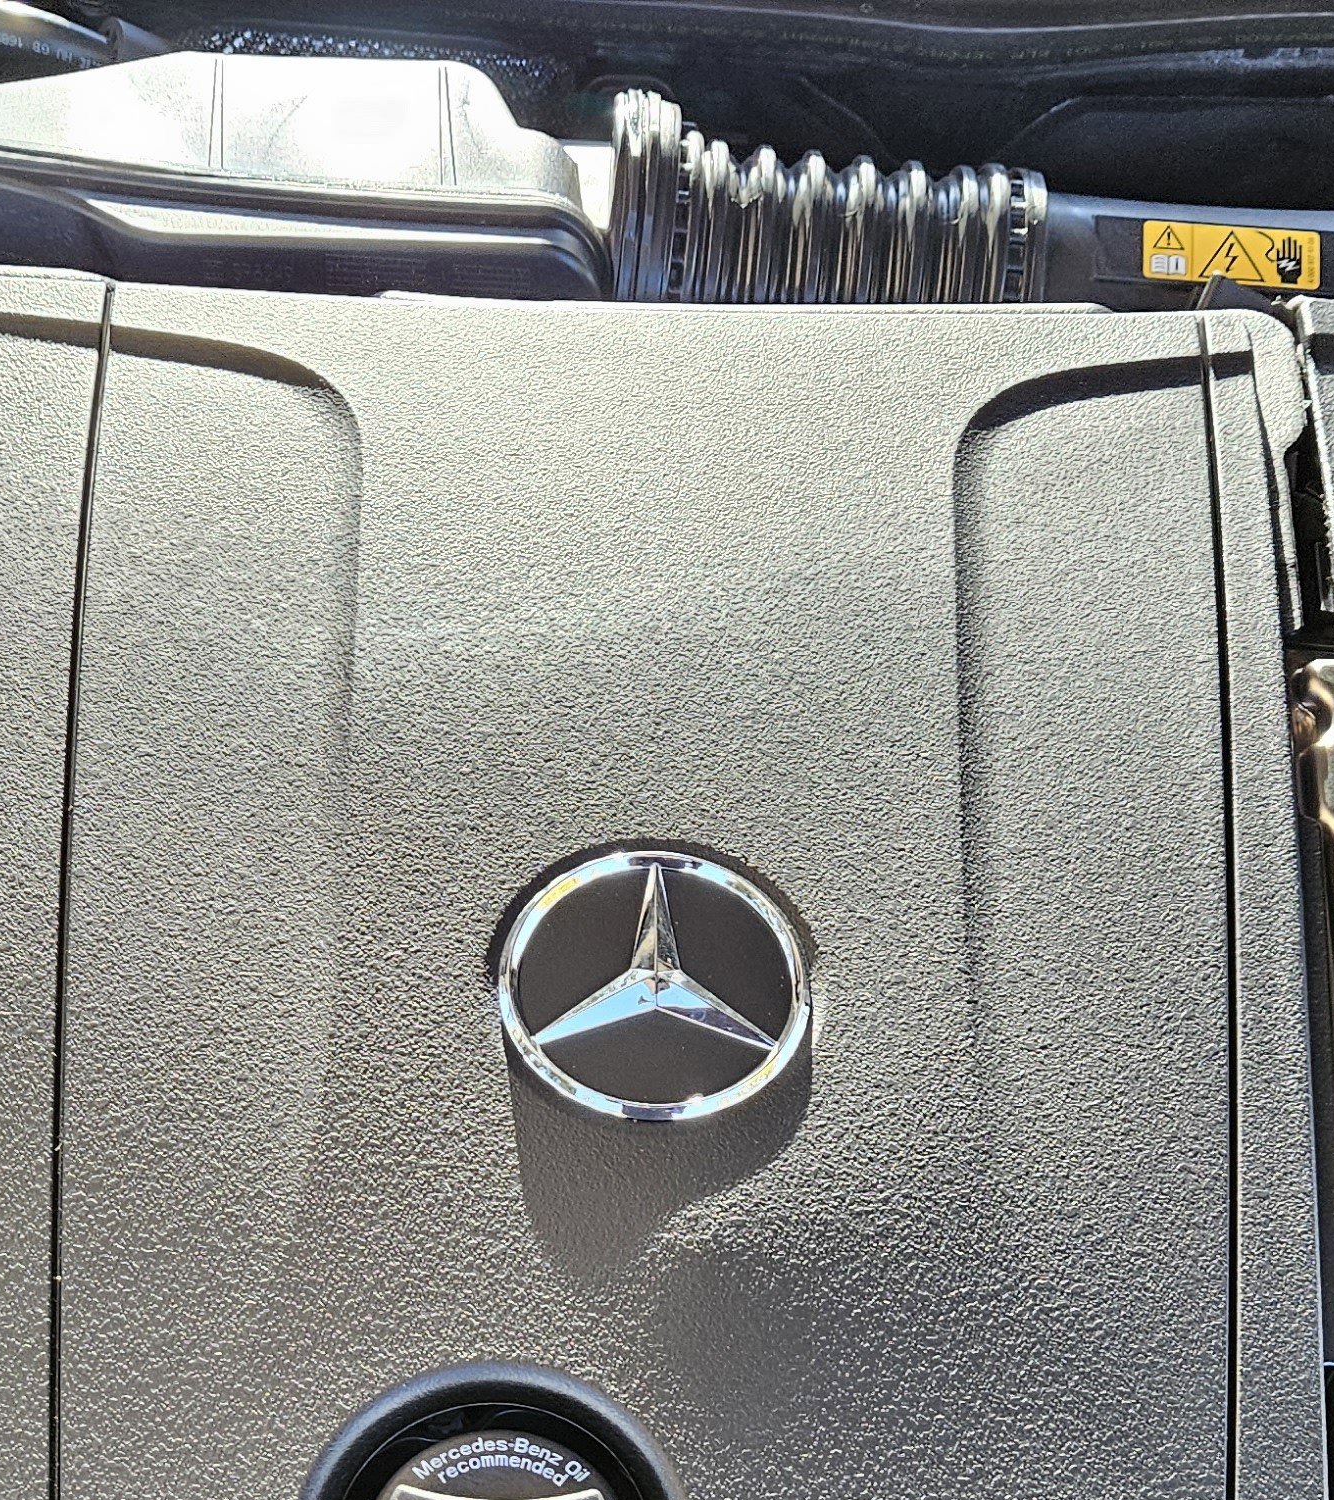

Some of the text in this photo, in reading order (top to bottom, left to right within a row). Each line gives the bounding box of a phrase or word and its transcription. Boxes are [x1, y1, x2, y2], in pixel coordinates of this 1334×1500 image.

[412, 1438, 590, 1483] Mercedes-Benz Oil
[437, 1454, 569, 1487] recommended
